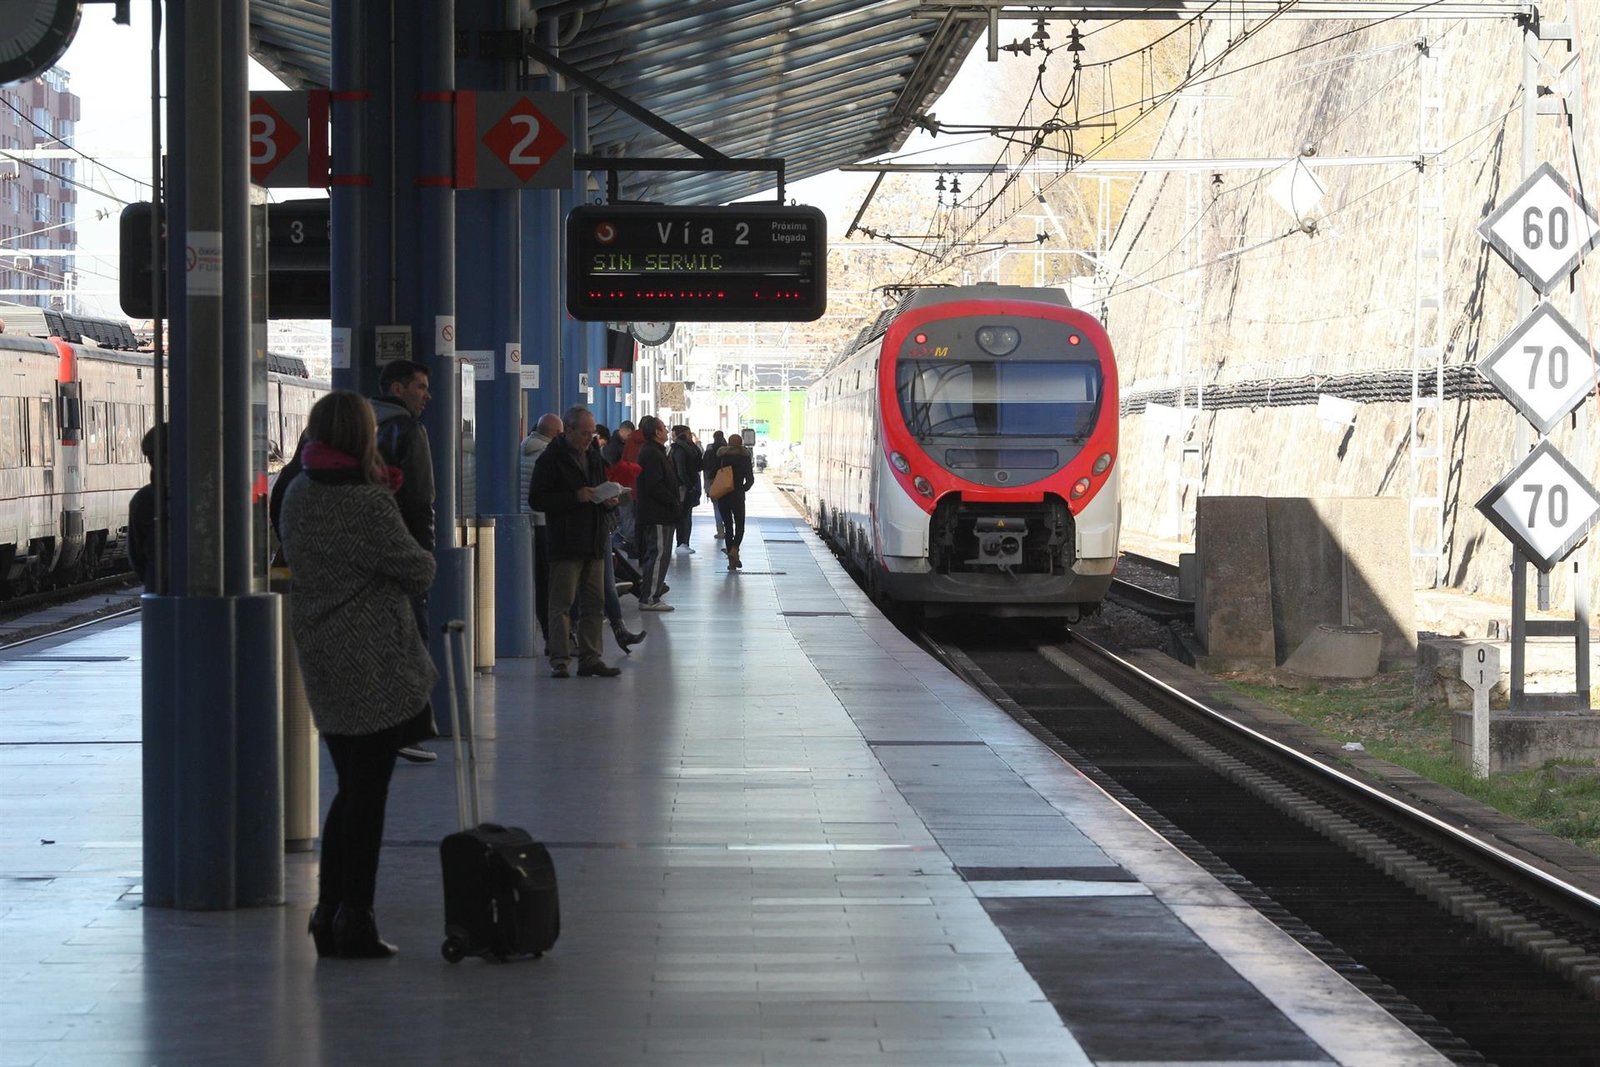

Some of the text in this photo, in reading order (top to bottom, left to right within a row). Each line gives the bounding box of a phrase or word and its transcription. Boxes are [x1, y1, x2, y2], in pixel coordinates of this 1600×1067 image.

[249, 114, 277, 165] 3
[508, 114, 541, 165] 2
[290, 220, 305, 244] 3
[657, 220, 750, 245] Vía 2
[771, 220, 808, 231] Próxima
[772, 232, 806, 244] Llegada
[1522, 206, 1569, 250] 60
[593, 254, 723, 270] SIN SERVIC
[1522, 345, 1569, 390] 70
[1523, 484, 1569, 528] 70
[1479, 670, 1484, 684] 1
